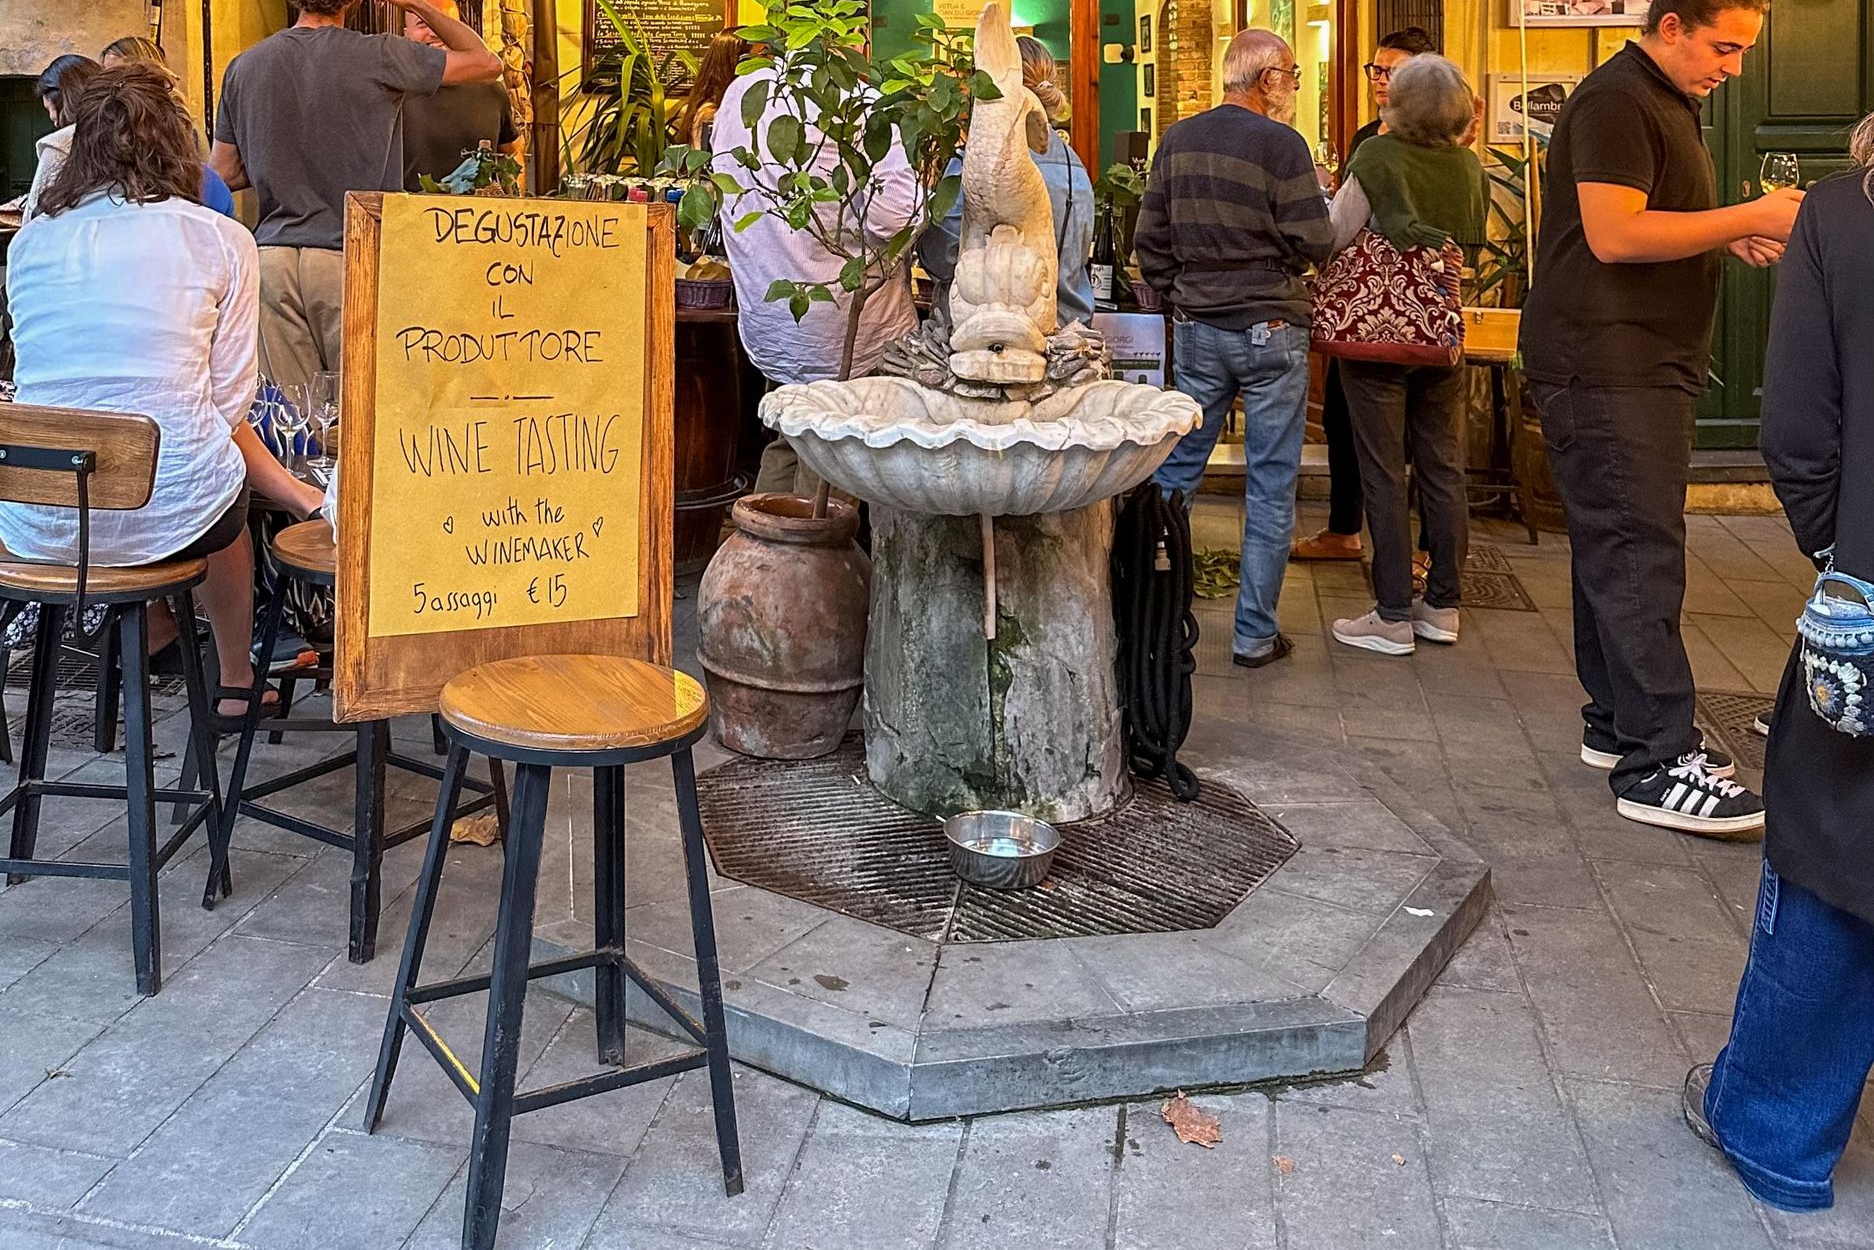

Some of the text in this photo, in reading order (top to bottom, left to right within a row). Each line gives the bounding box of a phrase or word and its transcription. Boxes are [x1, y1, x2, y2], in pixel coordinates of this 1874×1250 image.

[424, 207, 621, 257] DEGUSTAZIONE
[486, 261, 533, 286] CON
[492, 296, 514, 319] IL
[396, 326, 603, 364] PRODUTTORE
[400, 413, 622, 477] WINE TASTING
[481, 497, 565, 528] with the
[465, 531, 591, 565] WINEMAKER
